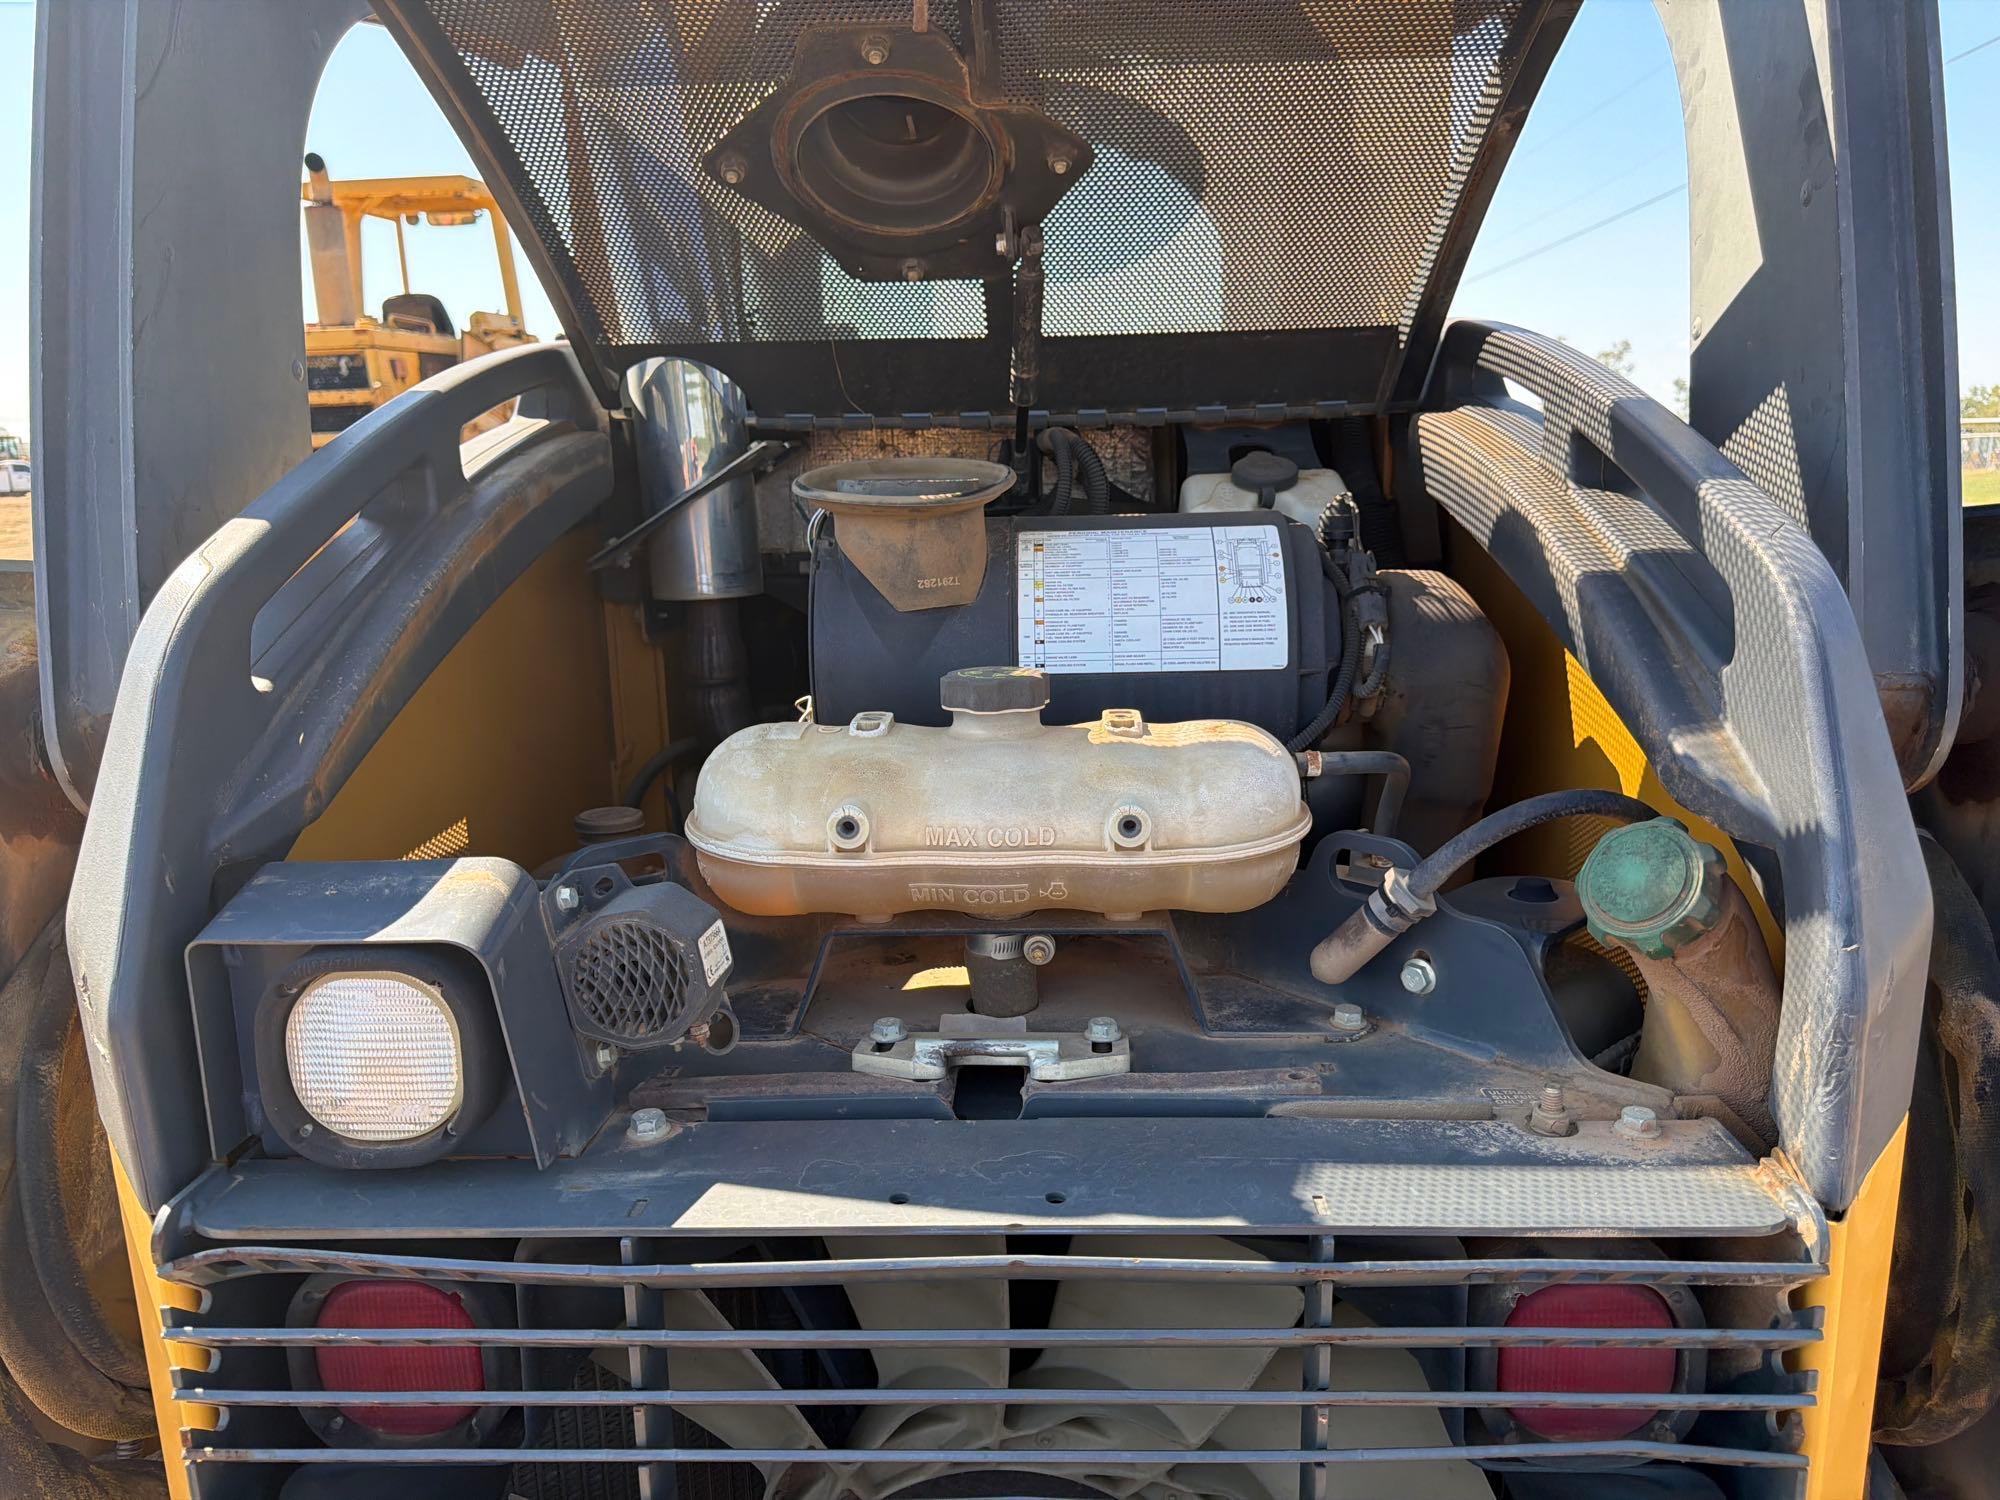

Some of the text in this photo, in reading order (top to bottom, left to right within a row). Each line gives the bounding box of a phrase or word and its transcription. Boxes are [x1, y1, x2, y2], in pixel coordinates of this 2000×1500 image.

[926, 825, 1056, 848] MAX COLD
[911, 887, 1031, 905] MIN COLD
